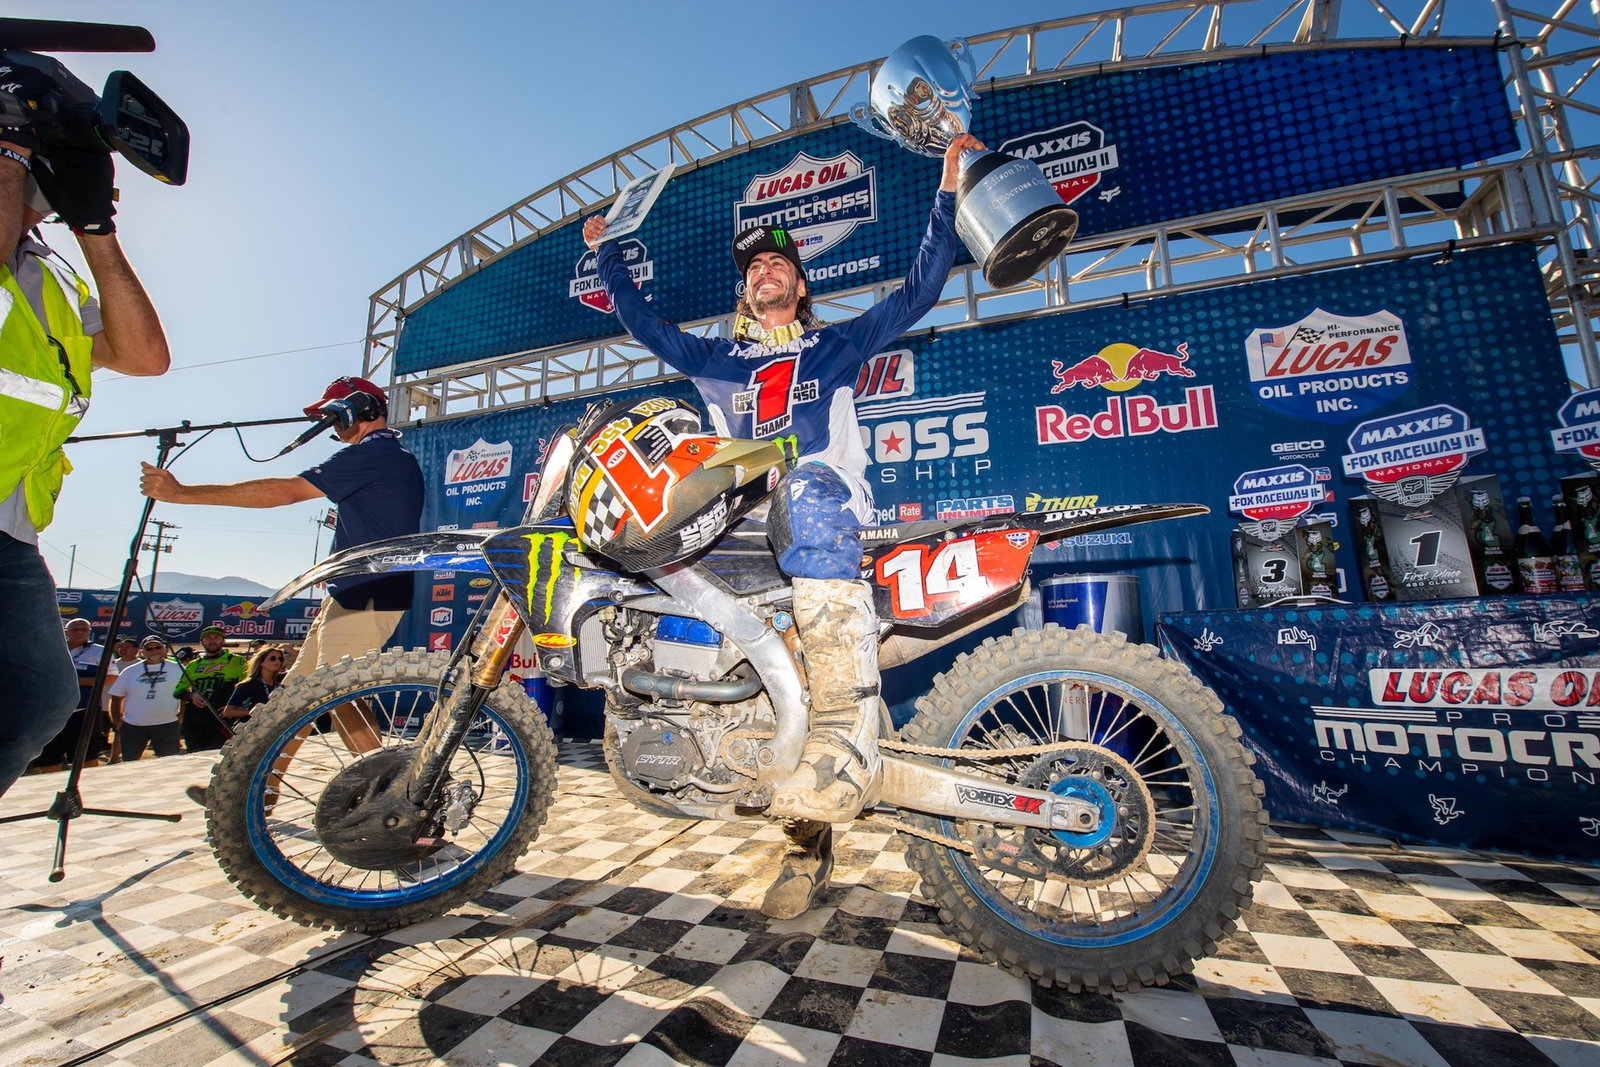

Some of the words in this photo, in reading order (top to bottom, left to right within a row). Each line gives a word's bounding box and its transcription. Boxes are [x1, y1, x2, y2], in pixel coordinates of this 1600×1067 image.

[1045, 156, 1097, 179] CEWAY
[756, 170, 815, 200] LUCAS
[818, 161, 848, 184] OIL
[740, 189, 869, 230] MOTOCROSS
[785, 195, 820, 208] PRO
[741, 228, 765, 245] YAMAHA
[574, 278, 592, 292] FOX
[1328, 324, 1401, 339] PERFORMANCE
[1266, 335, 1398, 377] LUCAS
[752, 357, 798, 426] 1
[793, 381, 816, 393] AMA
[1259, 384, 1293, 399] OIL
[1298, 371, 1409, 395] PRODUCTS
[734, 392, 754, 401] 2021
[793, 388, 816, 402] 450
[629, 399, 677, 417] 2021
[735, 400, 755, 412] MX
[1316, 397, 1358, 413] INC.
[1037, 396, 1124, 444] Red
[1125, 385, 1217, 436] Bull
[755, 414, 790, 438] CHAMP
[1361, 414, 1453, 446] MAXXIS
[1270, 439, 1325, 453] GEICO
[1350, 453, 1380, 470] FOX
[1383, 438, 1462, 464] RACEWAY
[1465, 434, 1475, 448] II
[608, 449, 625, 467] BELL
[1279, 453, 1320, 461] MOTORCYCLE
[451, 457, 508, 482] LUCAS
[1375, 459, 1454, 477] NATIONAL
[446, 488, 460, 497] OIL
[461, 481, 506, 494] PRODUCTS
[592, 435, 674, 531] 1
[1243, 471, 1305, 490] MAXXIS
[466, 497, 482, 507] INC.
[937, 496, 1013, 512] PARTS
[1041, 495, 1099, 511] THOR
[1234, 494, 1254, 508] FOX
[1256, 488, 1309, 505] RACEWAY
[900, 505, 921, 518] Rate
[938, 508, 1015, 520] UNLIMITED
[1043, 503, 1147, 523] DUNLOP
[1250, 503, 1303, 514] NATIONAL
[1063, 533, 1131, 547] SUZUKI
[1408, 530, 1443, 568] 1
[884, 538, 994, 611] 14
[1260, 557, 1288, 584] 3
[1430, 568, 1463, 580] Place
[436, 589, 451, 597] KTM
[156, 610, 200, 621] LUCAS
[245, 620, 275, 635] Bull
[1382, 671, 1538, 707] LUCAS
[1550, 671, 1600, 708] OI
[1446, 711, 1566, 728] PRO
[1313, 719, 1600, 769] MOTOCR
[635, 754, 681, 767] GYTR
[1319, 749, 1596, 786] CHAMPION
[954, 783, 1014, 809] VORTEX
[933, 843, 978, 911] DUNLO
